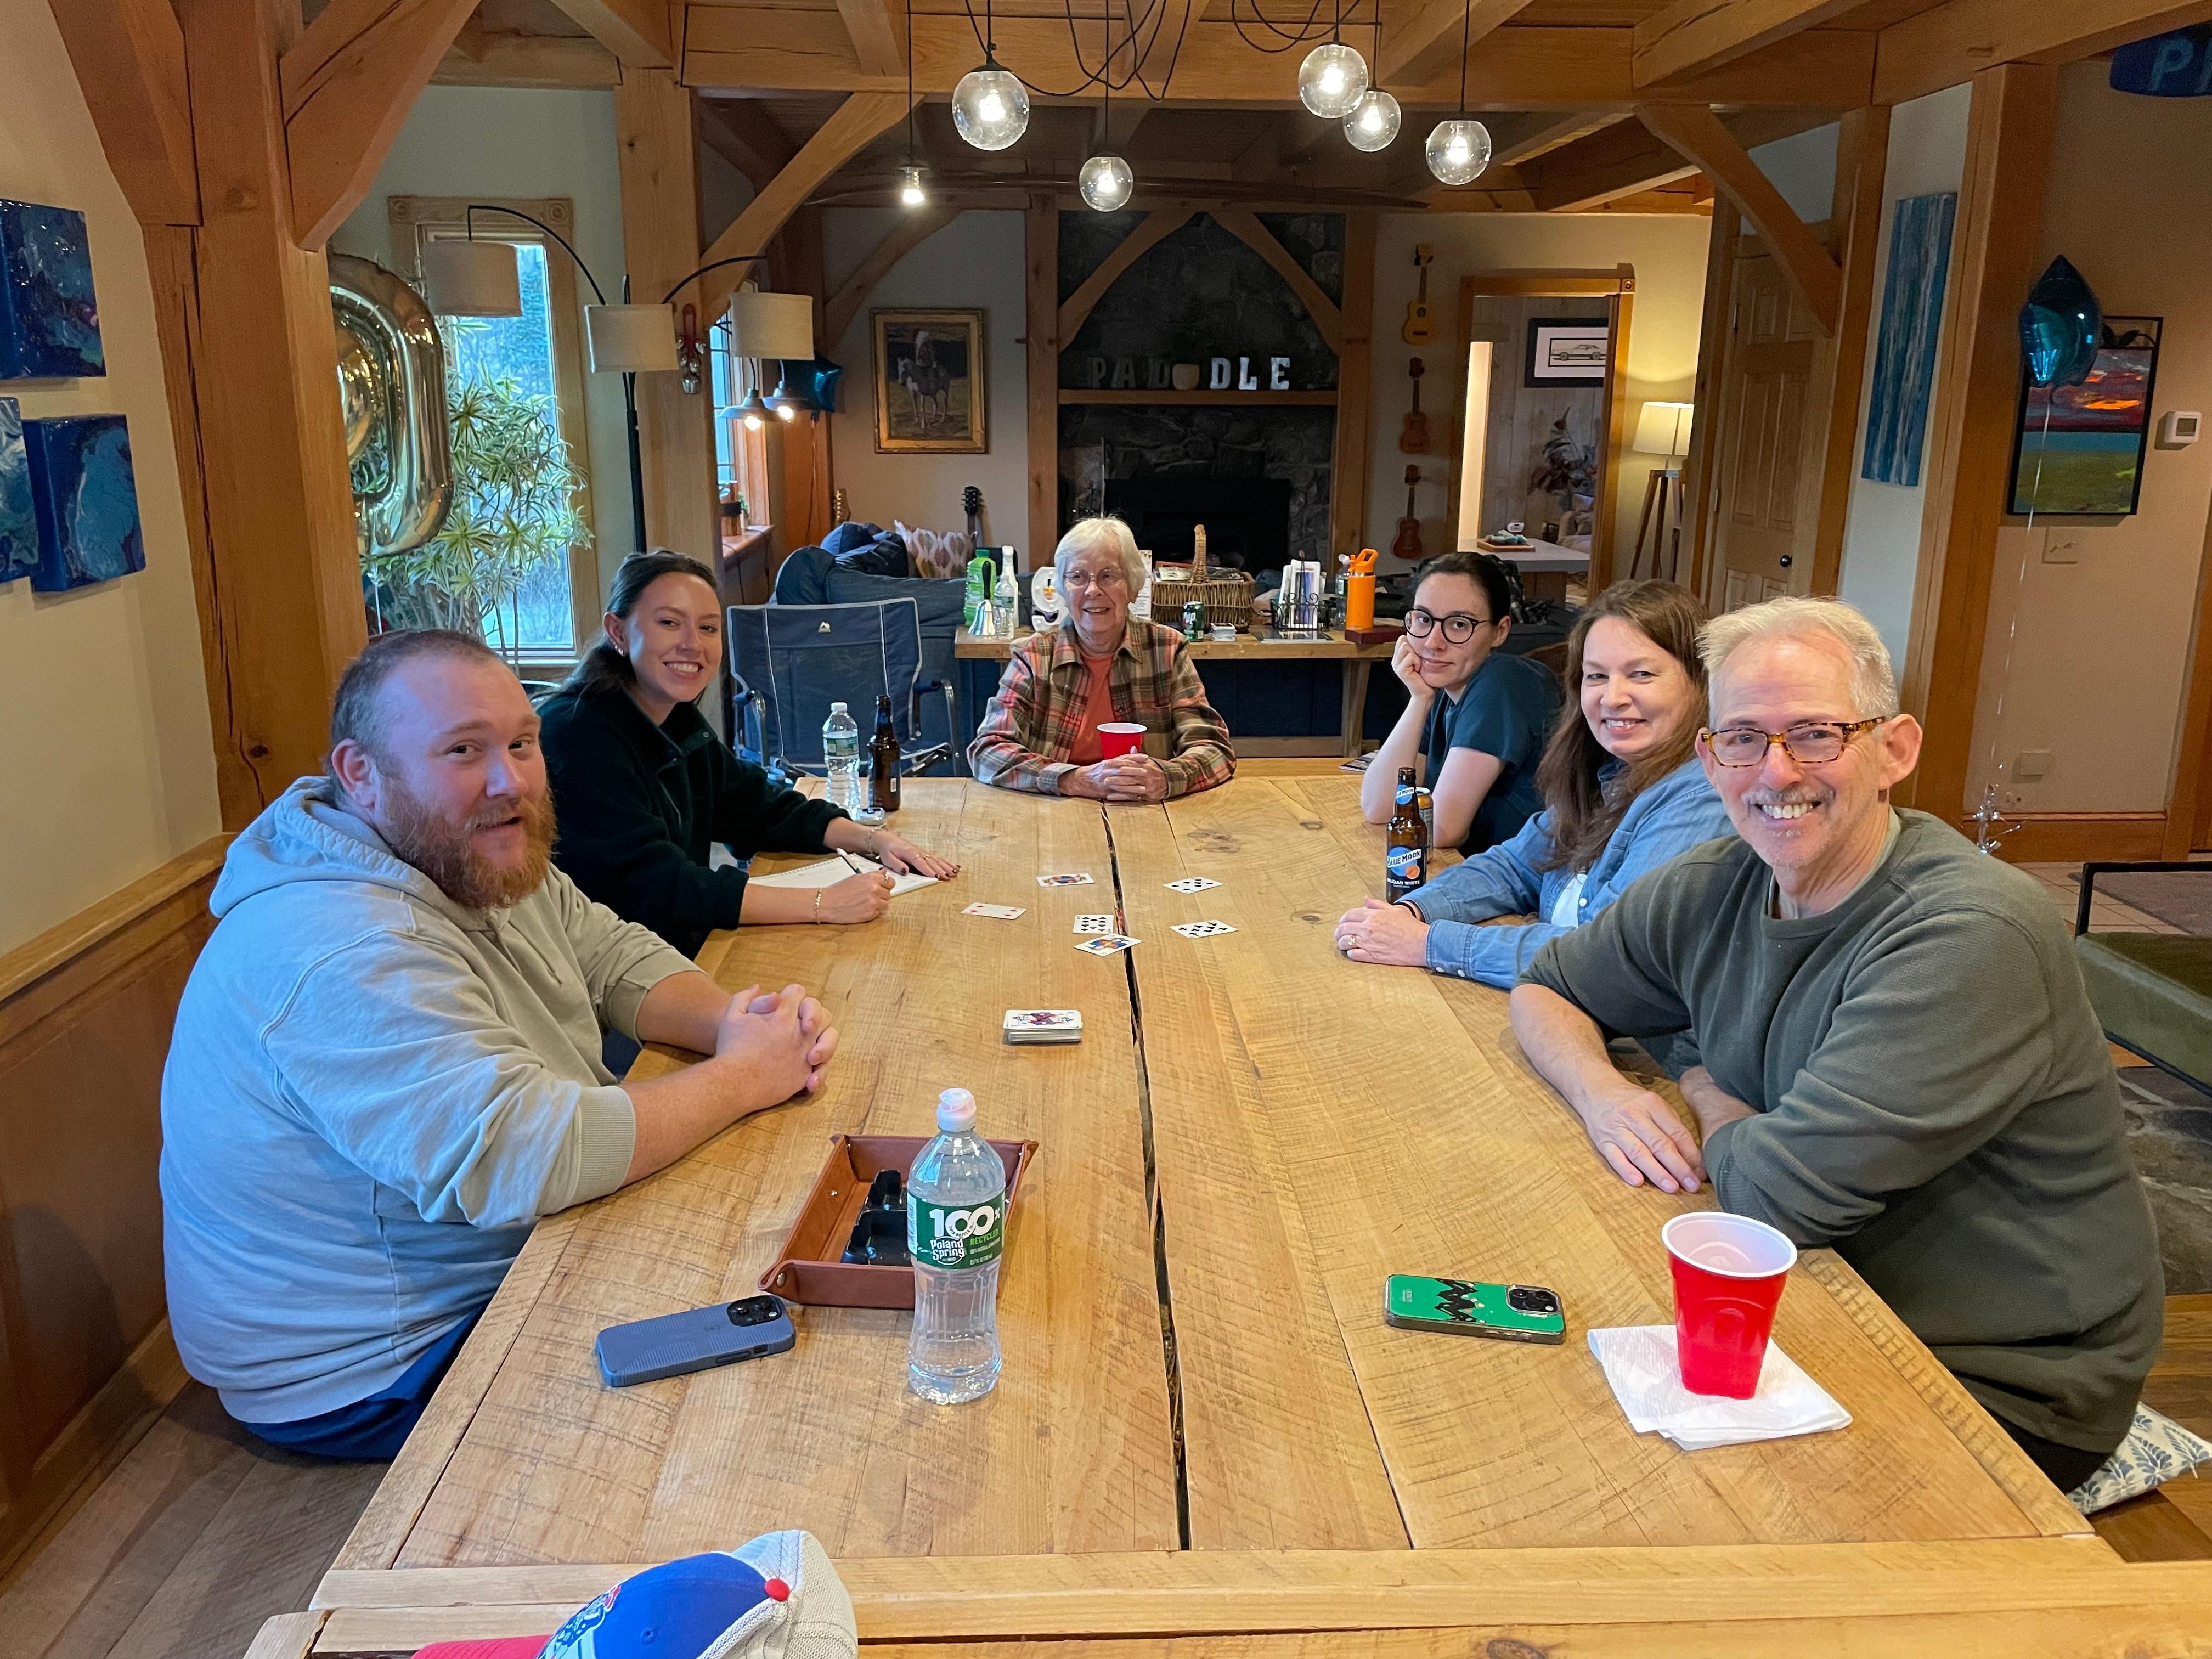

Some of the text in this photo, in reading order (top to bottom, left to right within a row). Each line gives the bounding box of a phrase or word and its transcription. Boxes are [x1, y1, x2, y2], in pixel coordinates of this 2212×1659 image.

[1402, 849, 1421, 862] MOON
[970, 1228, 998, 1246] RECYCLED
[930, 1238, 964, 1250] Poland
[932, 1248, 966, 1261] Spring
